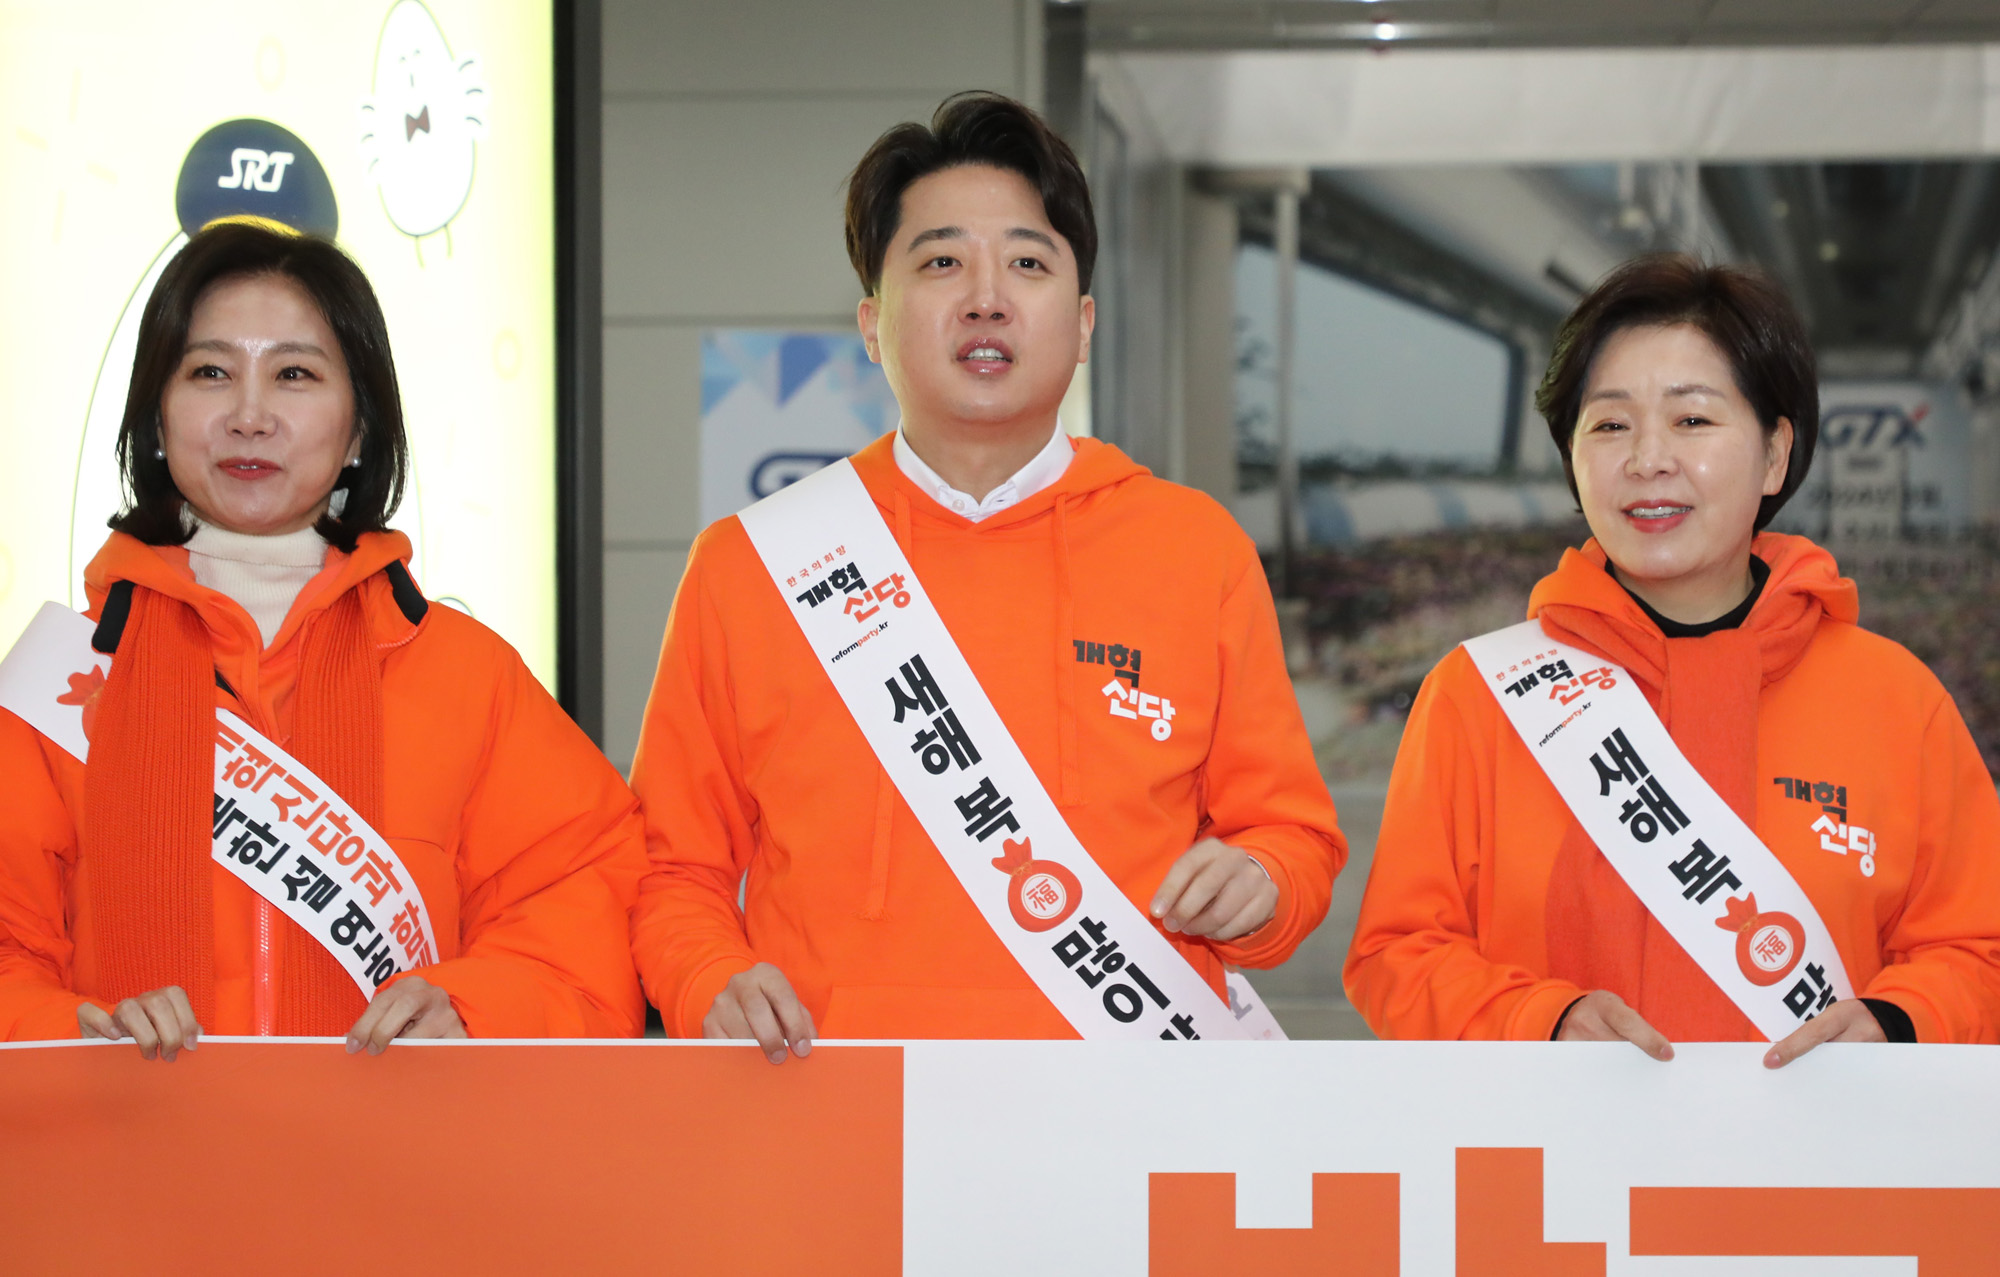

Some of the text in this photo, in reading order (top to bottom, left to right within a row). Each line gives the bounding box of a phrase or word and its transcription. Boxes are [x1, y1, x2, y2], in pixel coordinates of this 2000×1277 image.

[218, 148, 295, 192] SRT
[796, 561, 868, 609] 개혁
[843, 572, 911, 624] 신당
[831, 621, 889, 663] reformparty.kr
[1073, 639, 1142, 688] 개혁
[1504, 659, 1574, 698] 개혁
[1549, 666, 1617, 706] 신당
[1101, 679, 1176, 741] 신당
[1539, 701, 1592, 747] reformparty.kr
[1589, 727, 1691, 843] 새해
[1667, 838, 1743, 905] 복
[1773, 777, 1848, 823] 개혁
[885, 653, 1172, 1024] 새해 복 많이
[1811, 813, 1877, 877] 신당
[281, 854, 342, 914] 설
